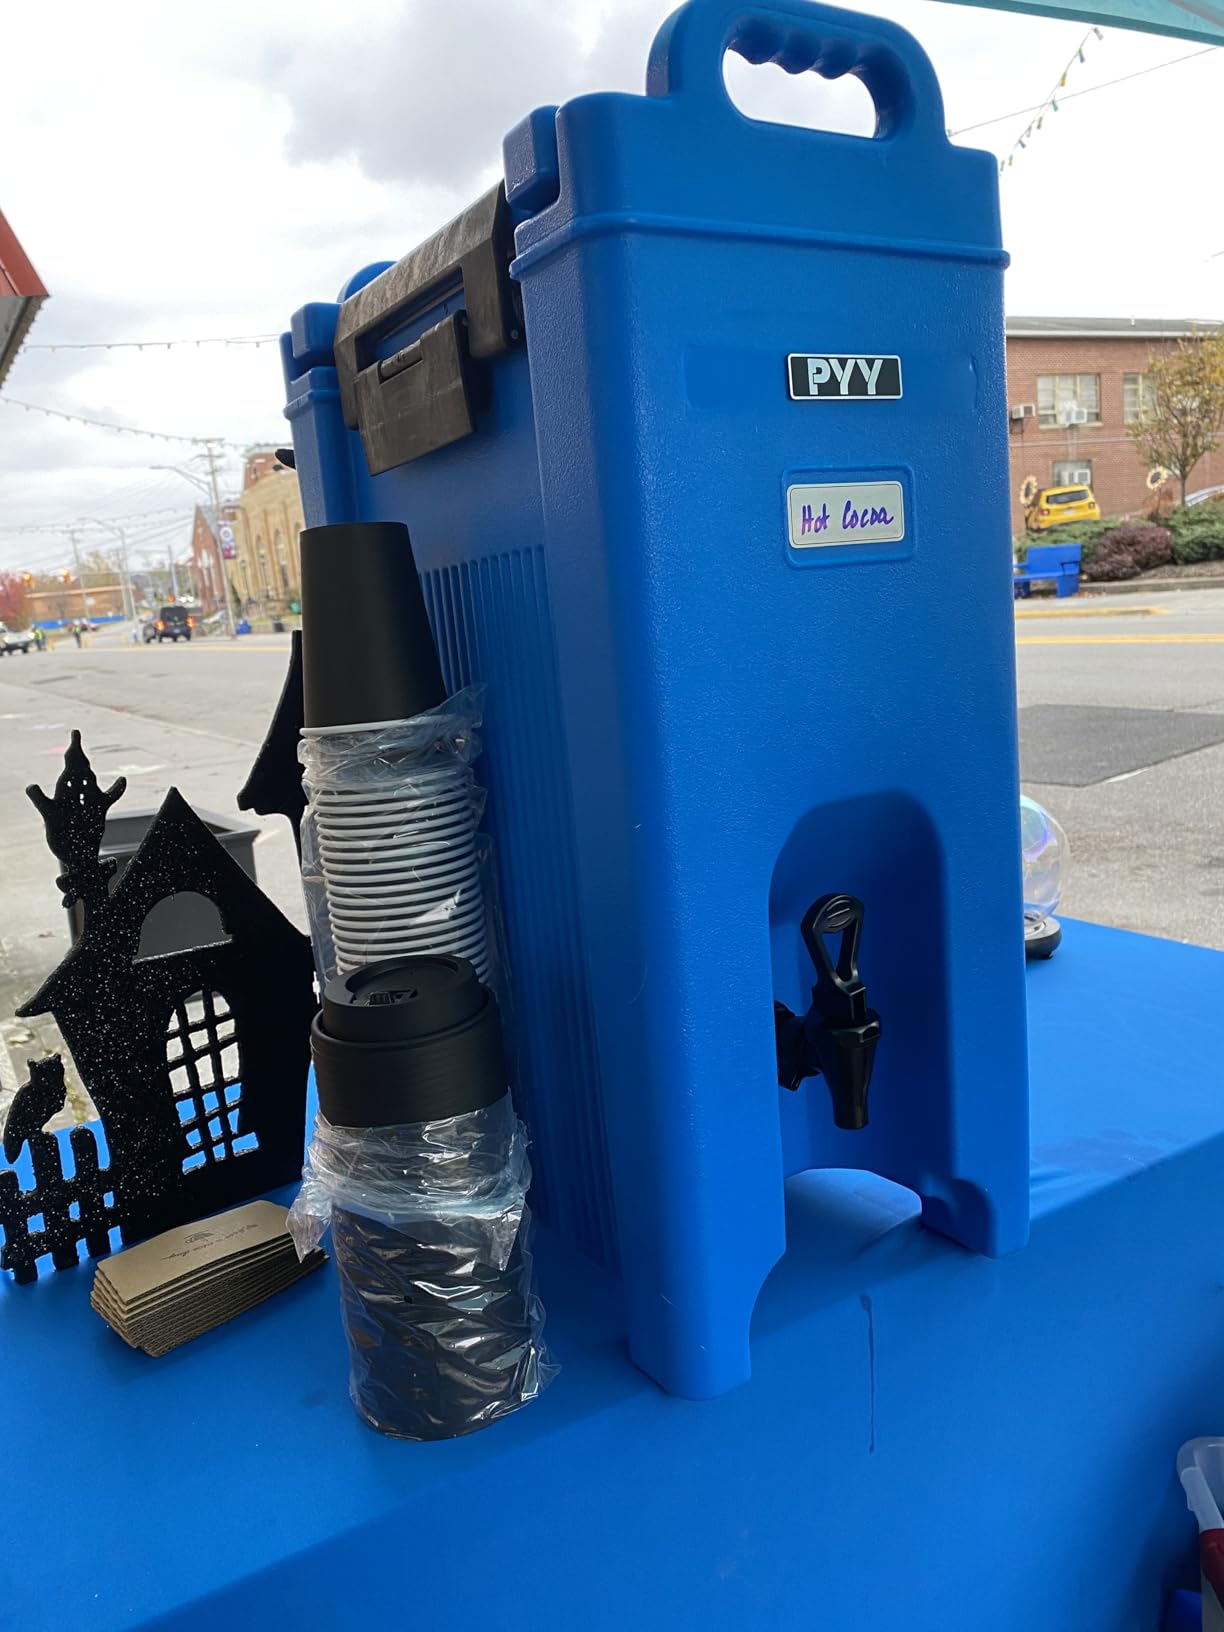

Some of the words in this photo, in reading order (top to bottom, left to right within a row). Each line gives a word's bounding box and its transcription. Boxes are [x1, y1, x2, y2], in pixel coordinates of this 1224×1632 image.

[807, 358, 883, 395] PYY
[801, 503, 830, 535] Hot
[842, 500, 894, 529] Cocoa
